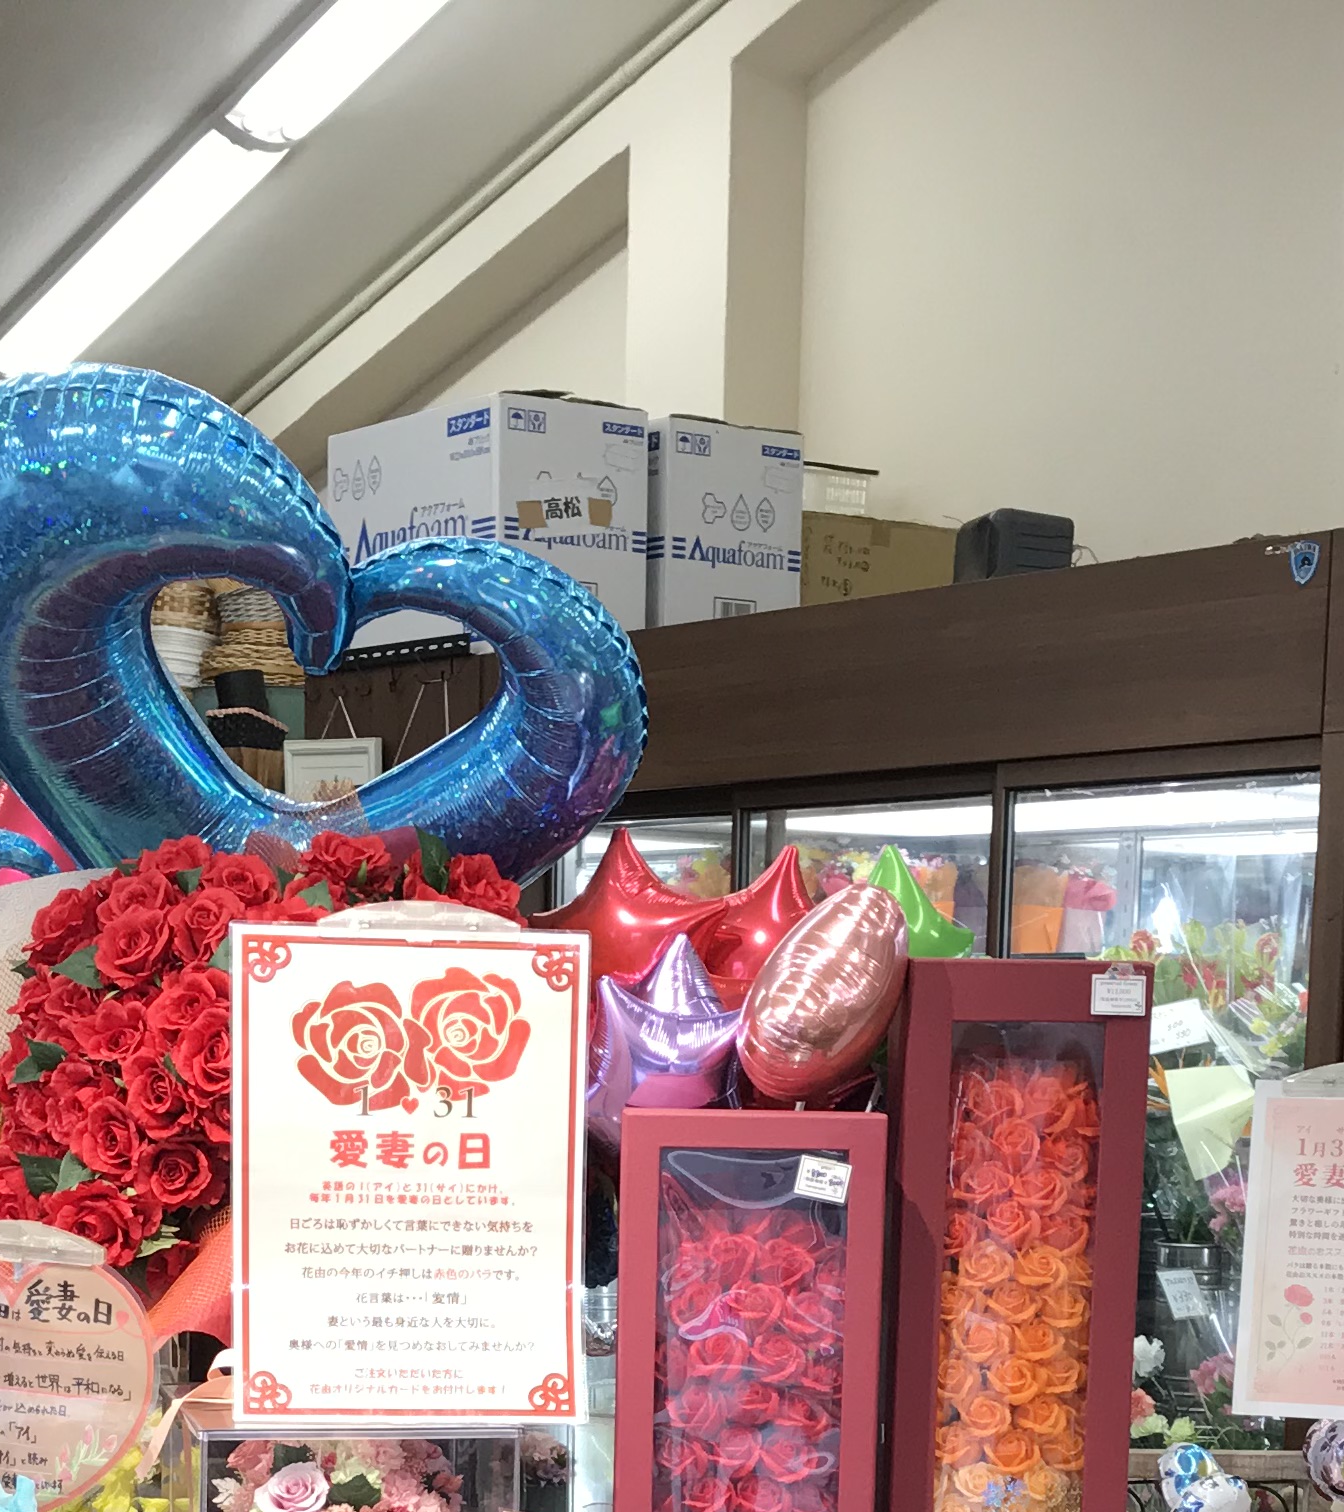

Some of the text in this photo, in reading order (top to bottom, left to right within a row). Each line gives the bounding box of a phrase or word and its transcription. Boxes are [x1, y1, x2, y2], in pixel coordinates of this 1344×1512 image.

[544, 496, 582, 520] 高松
[688, 535, 785, 570] Aquafoam
[432, 1086, 478, 1118] 31
[330, 1130, 491, 1170] 愛妻の日
